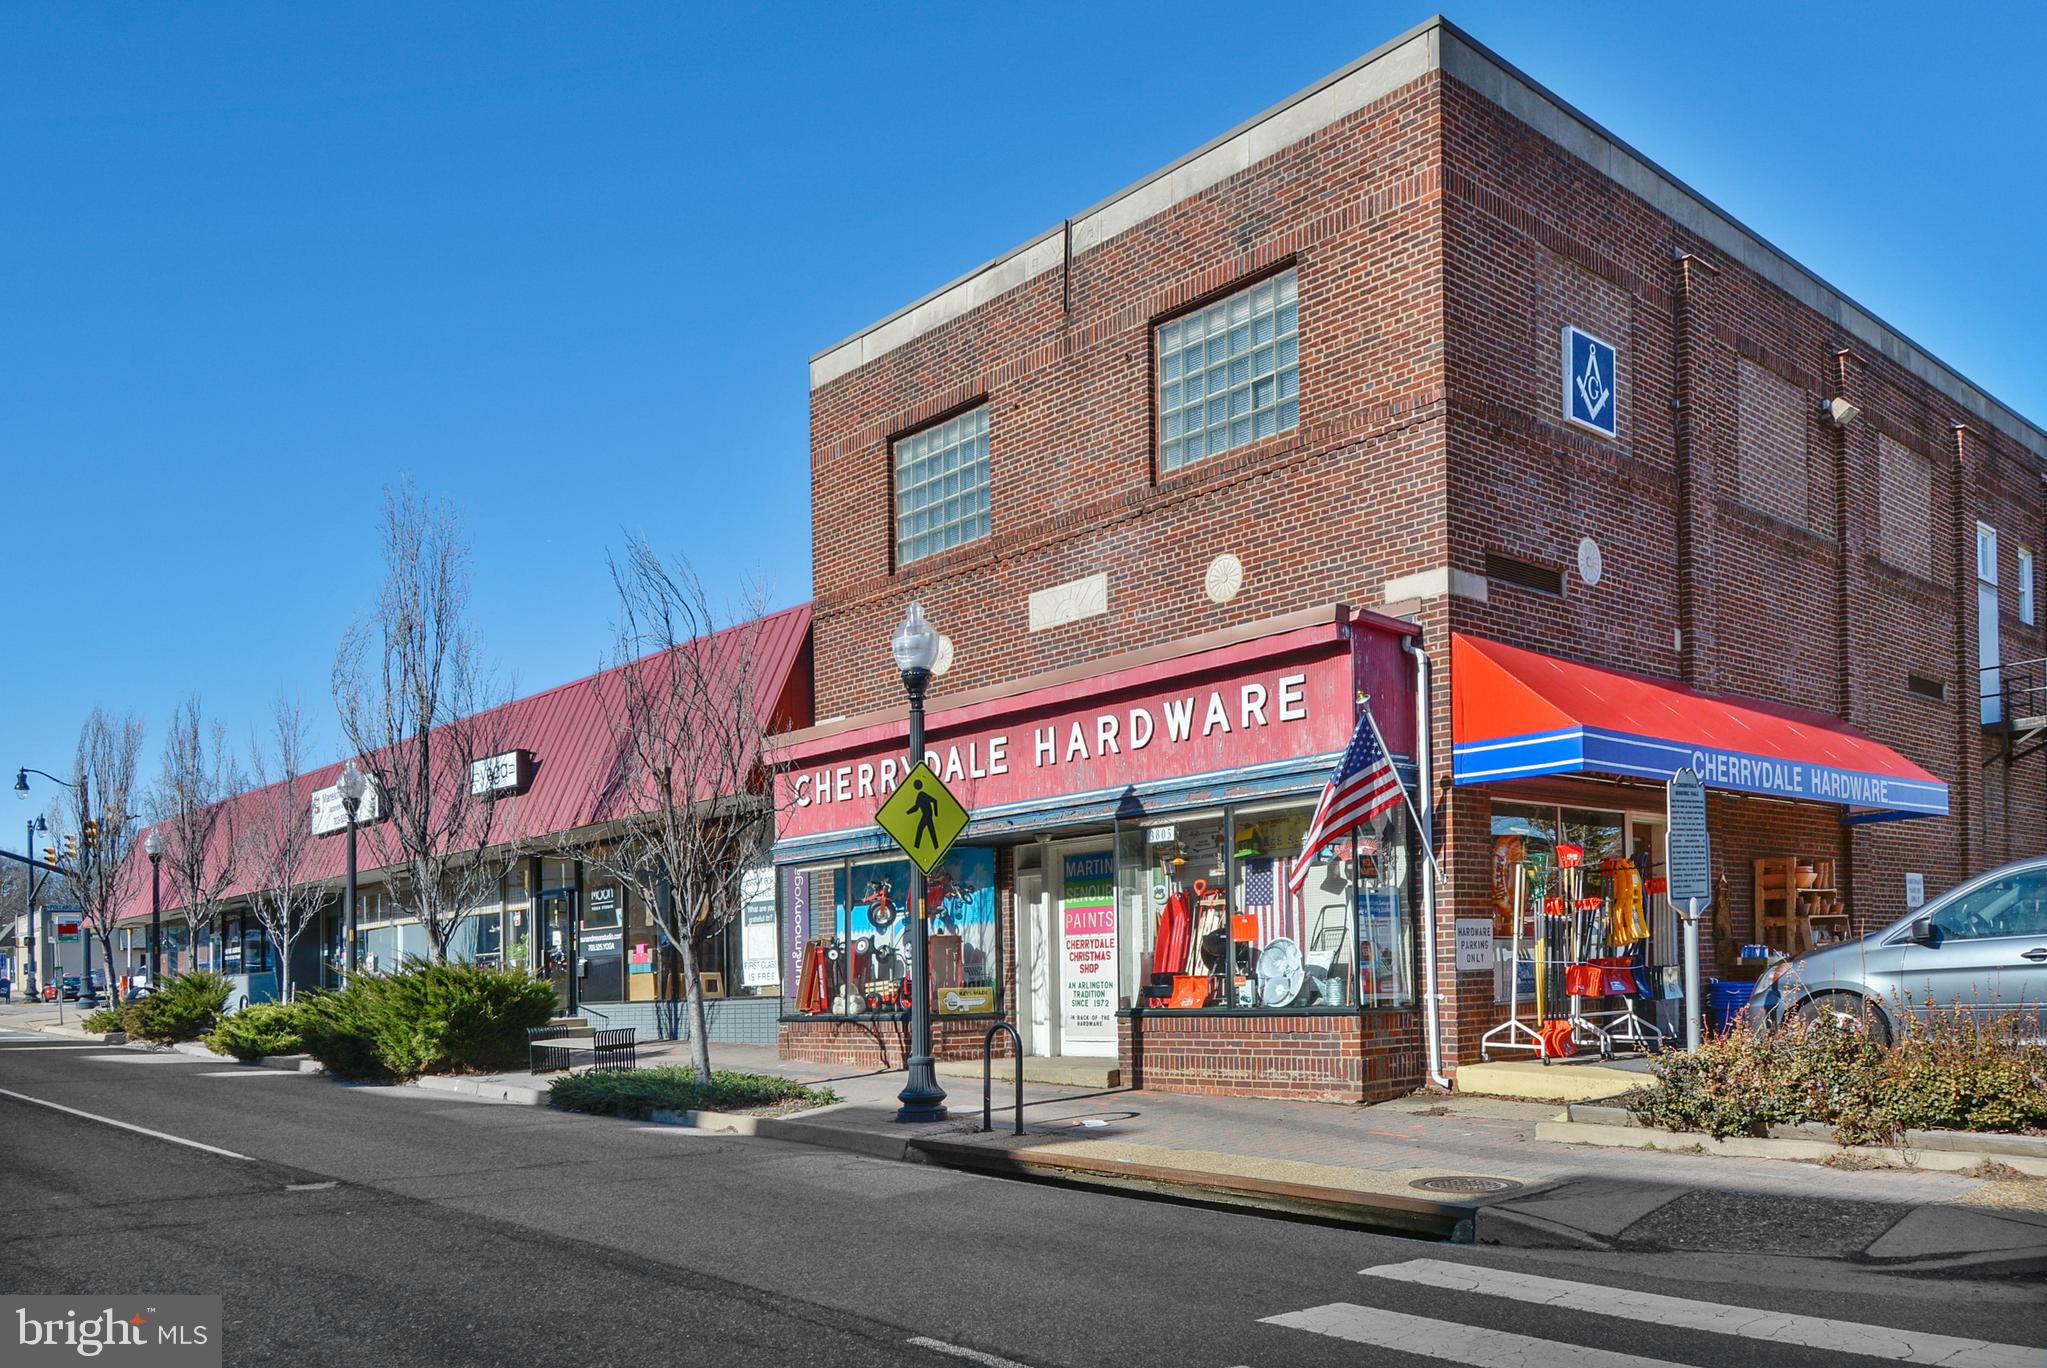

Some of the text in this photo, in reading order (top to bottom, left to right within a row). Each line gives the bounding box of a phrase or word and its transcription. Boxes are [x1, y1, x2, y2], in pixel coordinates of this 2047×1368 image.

[1588, 376, 1600, 400] G
[1034, 673, 1306, 767] HARDWARE
[1692, 751, 1889, 803] CHERRYDALE HARDWARE
[1065, 858, 1113, 878] MARTIN
[1066, 885, 1114, 904] SENOUR
[1066, 910, 1114, 929] PAINTS
[1458, 927, 1491, 938] HARDWARE
[1066, 938, 1115, 950] CHERRYDALE
[1461, 941, 1489, 951] PARKING
[1069, 951, 1112, 962] CHRISTMAS
[1466, 953, 1485, 963] ONLY
[1079, 963, 1100, 974] SHOP
[748, 972, 775, 981] IS FREE
[1078, 981, 1113, 989] ARLINGTON
[1073, 990, 1106, 998] TRADITION
[1071, 1000, 1110, 1008] SINCE 1972
